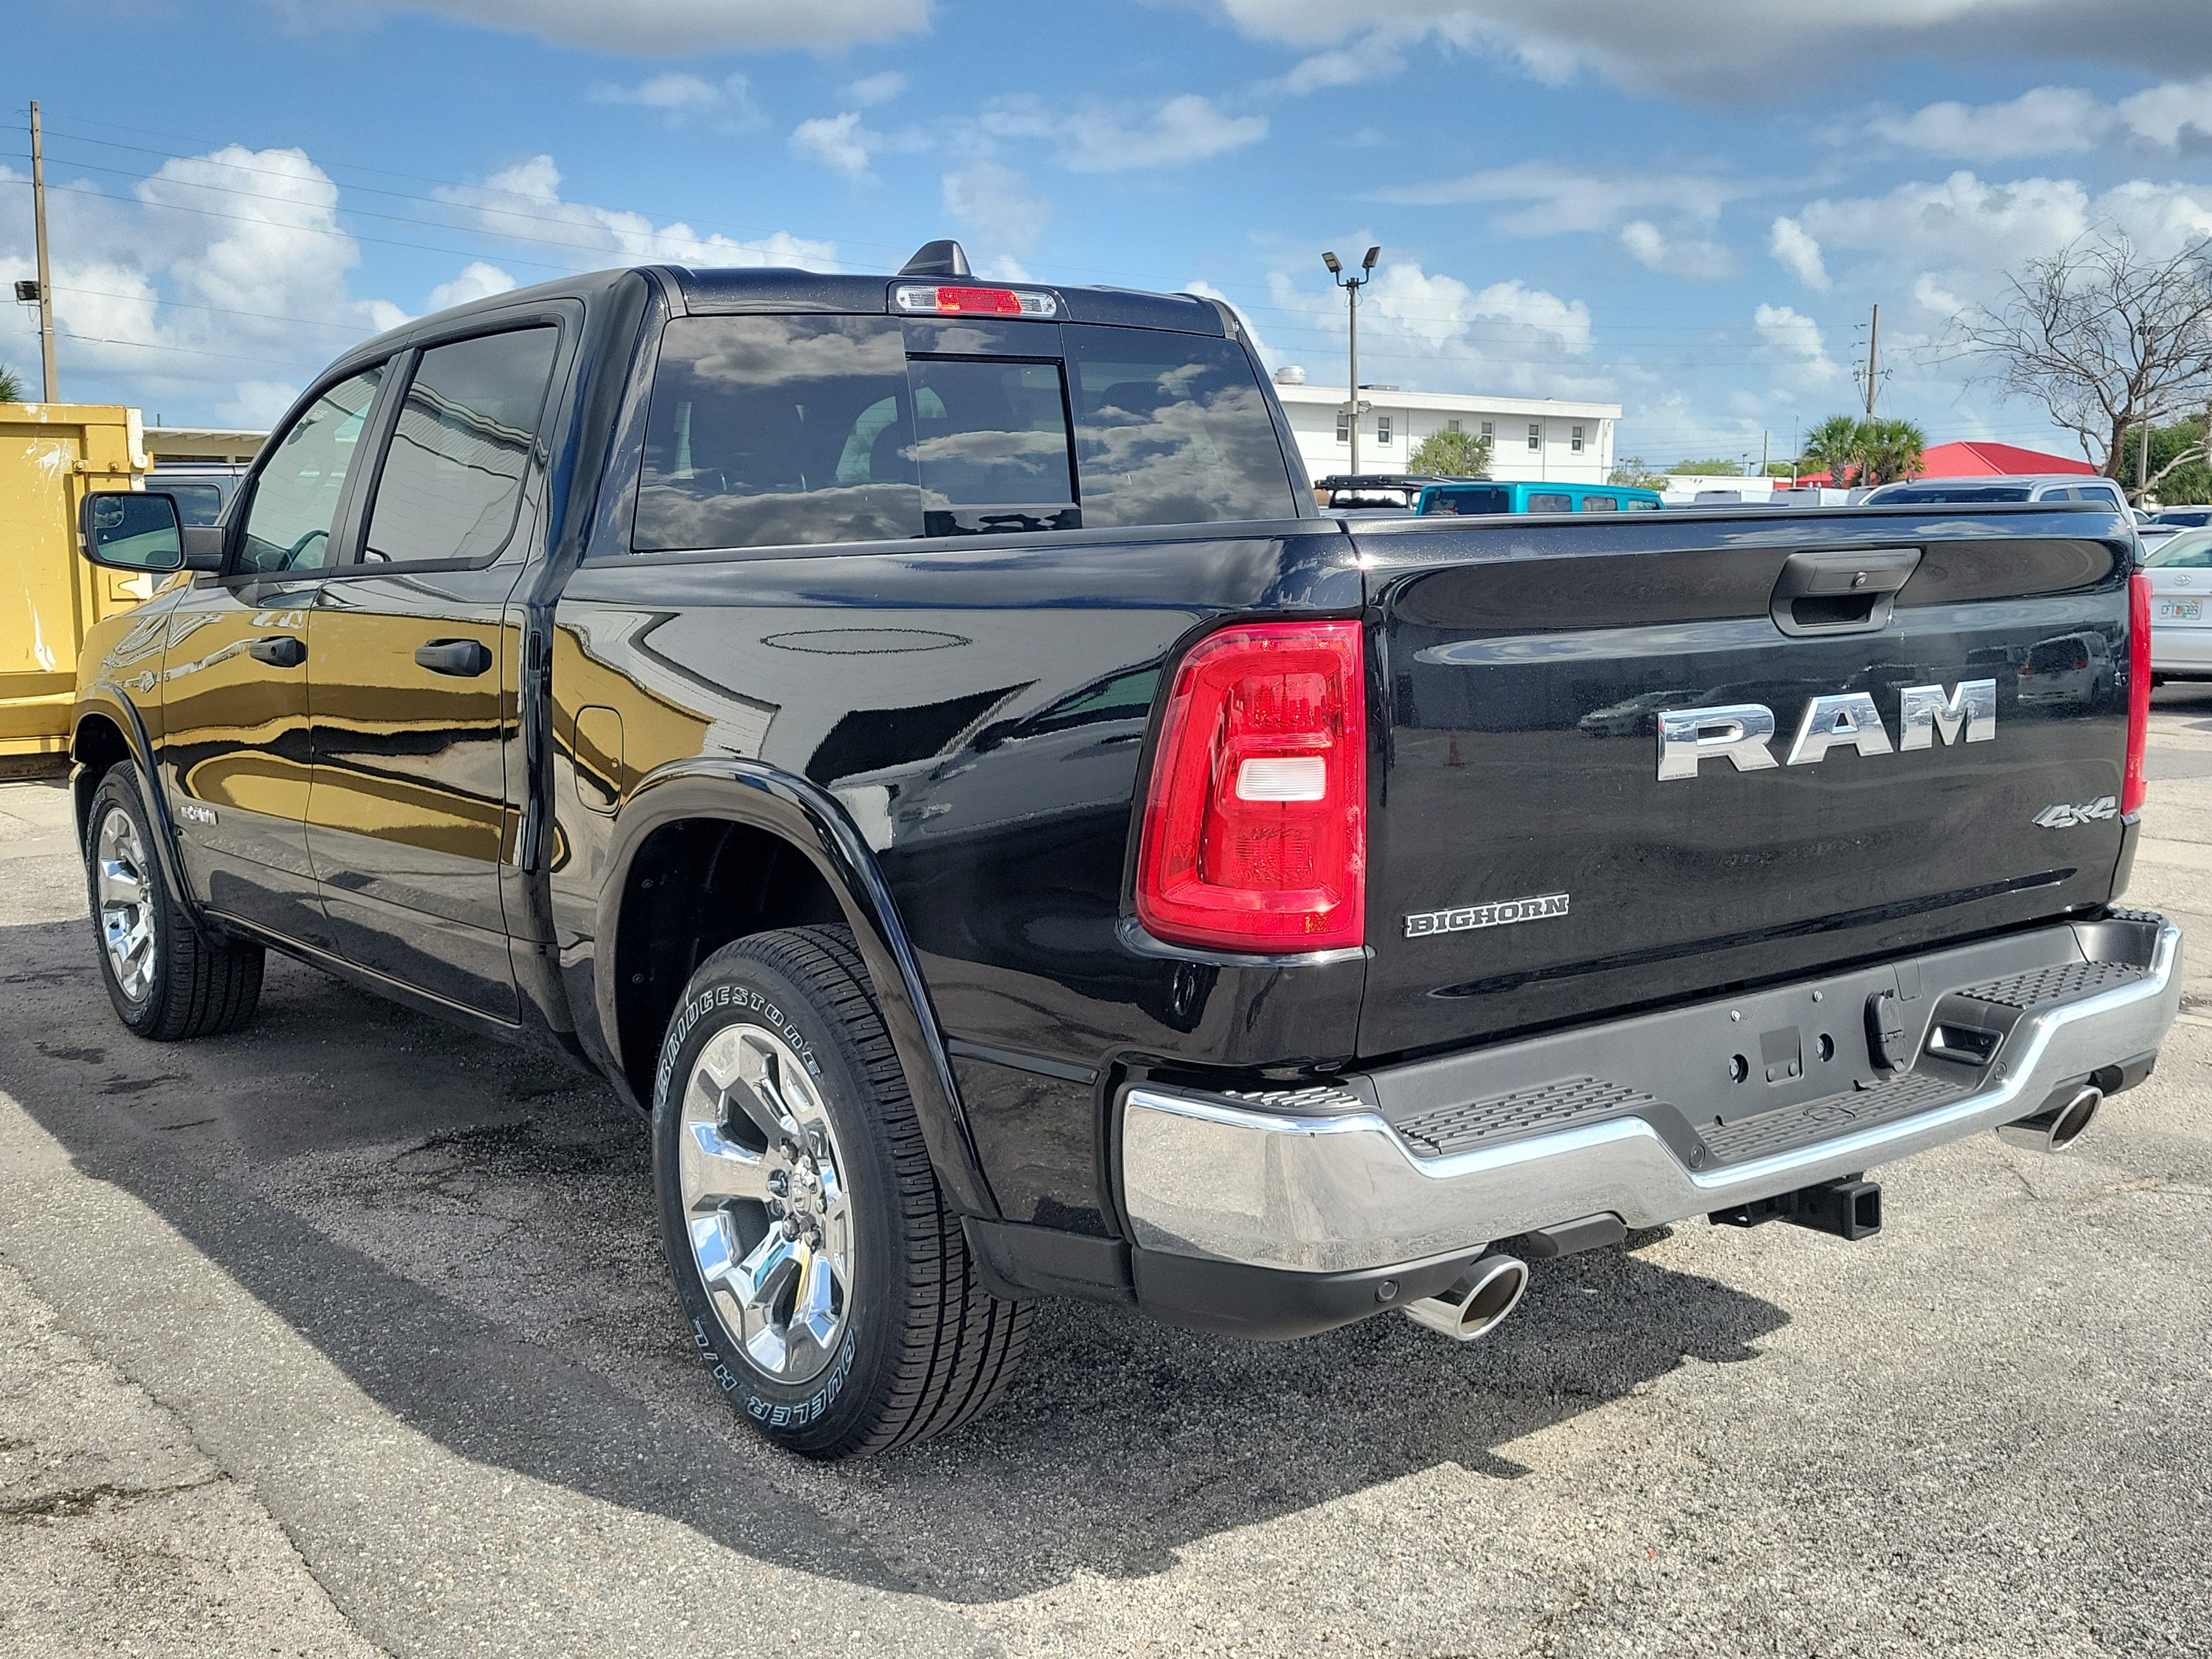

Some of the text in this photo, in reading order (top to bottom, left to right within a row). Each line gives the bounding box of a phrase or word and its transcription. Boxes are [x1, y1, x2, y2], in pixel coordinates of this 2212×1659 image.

[1657, 678, 1996, 781] RAM
[1403, 893, 1570, 938] BIGHORN
[658, 986, 821, 1104] BRIDGESTONE
[747, 1329, 855, 1426] DUELER
